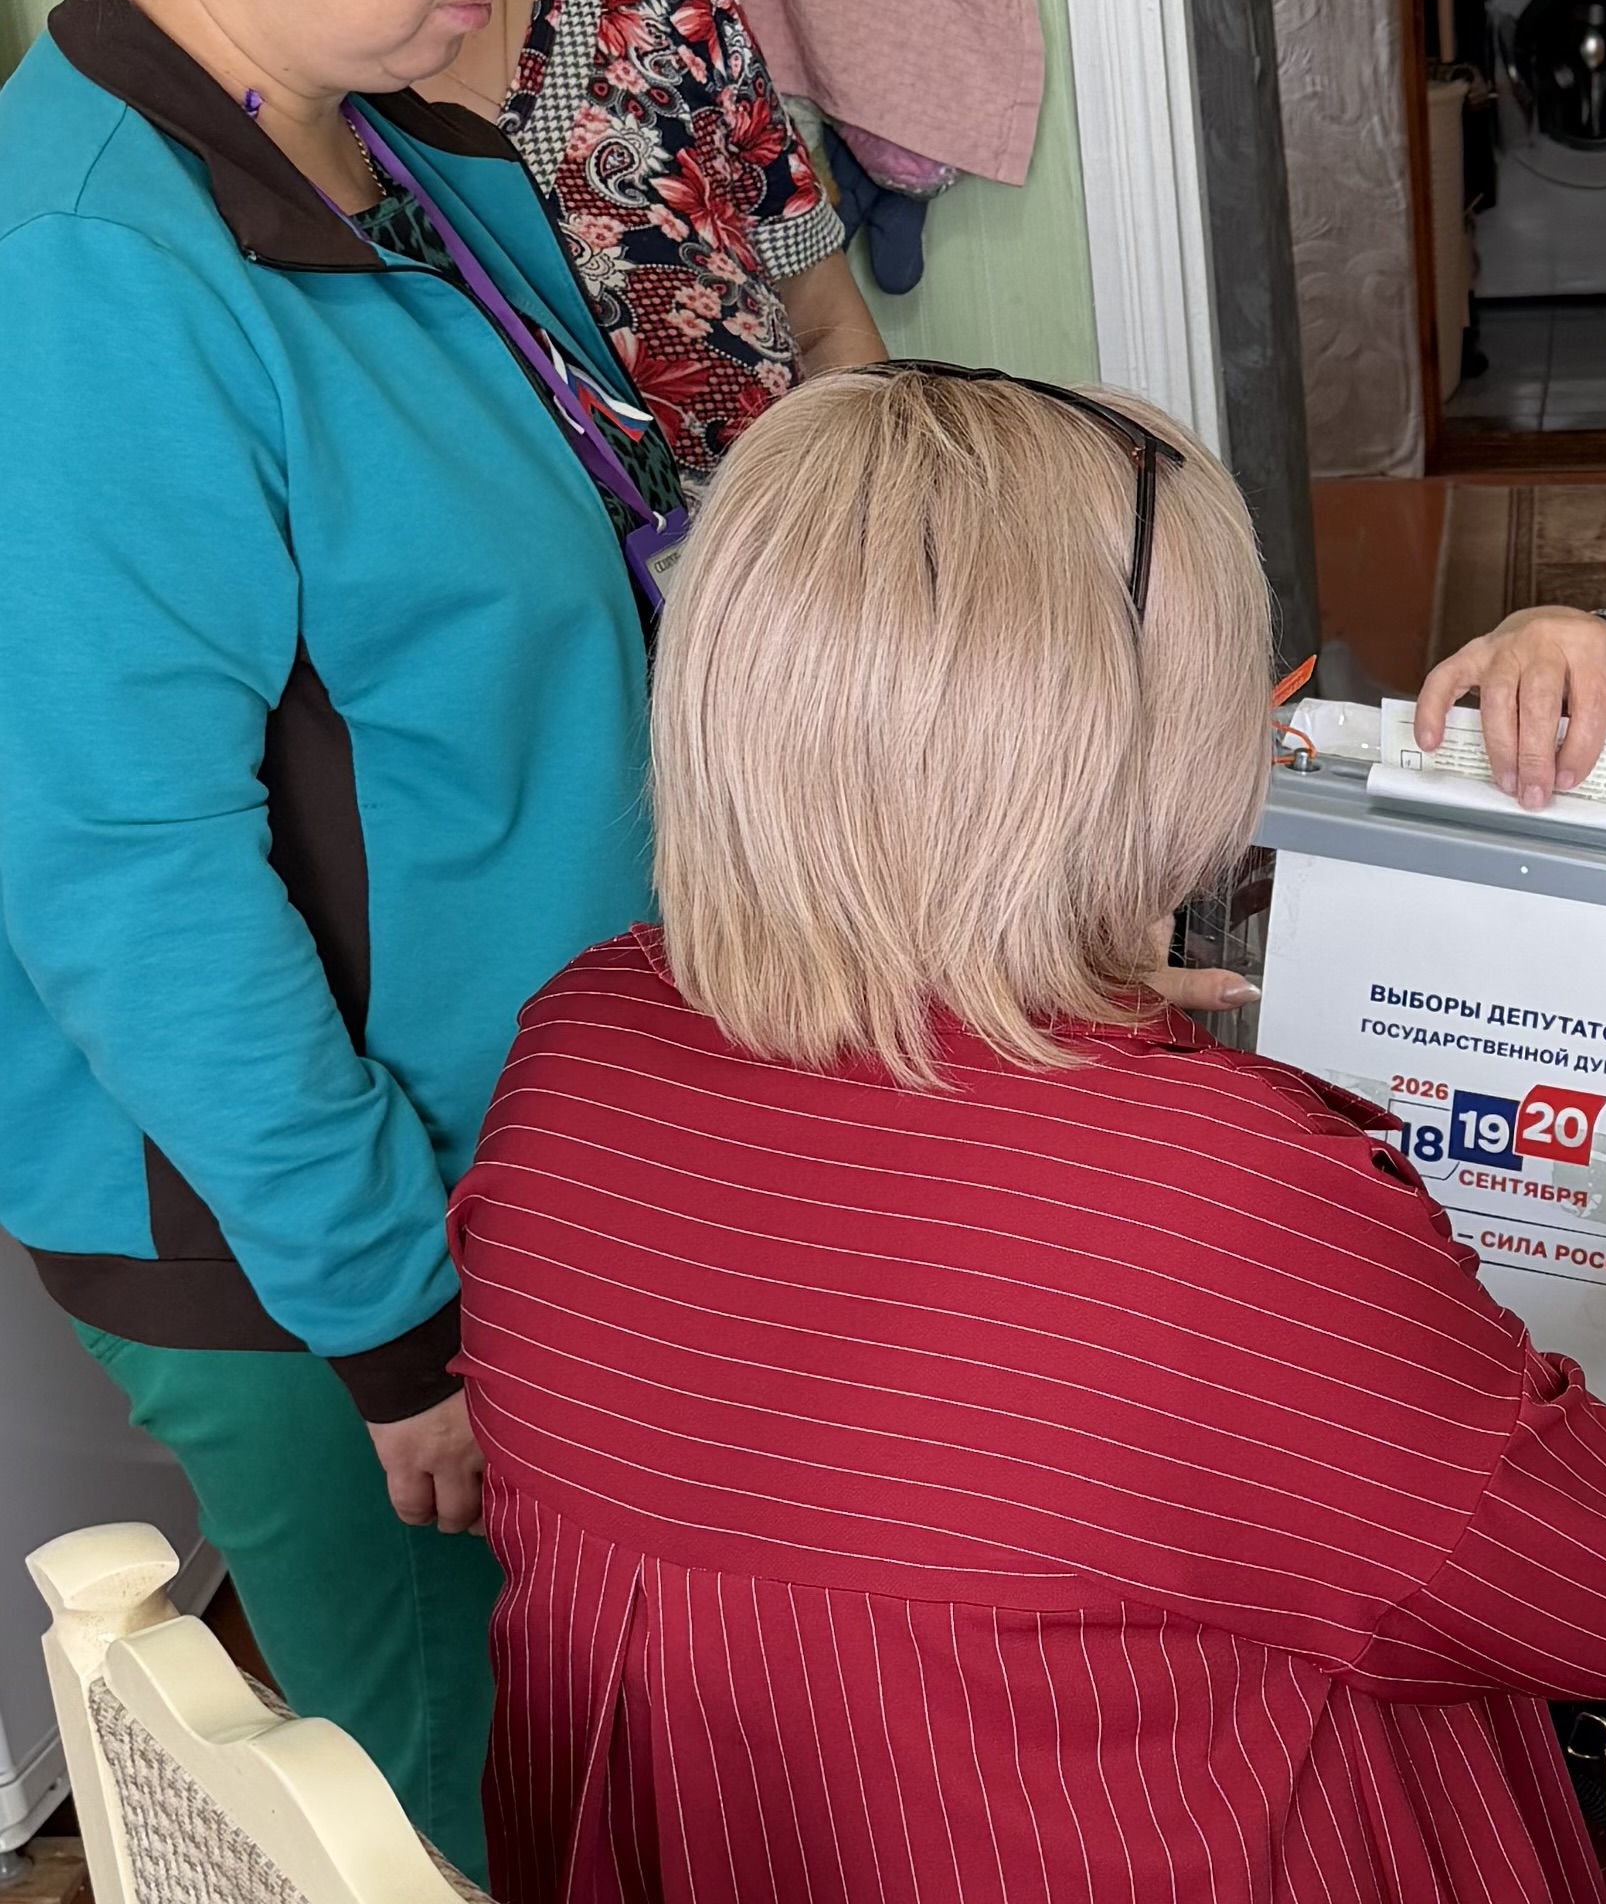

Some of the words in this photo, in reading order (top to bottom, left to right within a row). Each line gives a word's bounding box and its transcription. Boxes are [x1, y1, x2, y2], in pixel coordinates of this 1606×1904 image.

[1369, 983, 1482, 1020] ВЫБОРЫ
[1360, 1017, 1569, 1068] ГОСУДАРСТВЕННОЙ
[1390, 1074, 1450, 1101] 2026
[1458, 1109, 1511, 1154] 19
[1521, 1101, 1589, 1149] 20
[1458, 1168, 1589, 1209] СЕНТЯБРЯ
[1480, 1230, 1548, 1260] СИЛА
